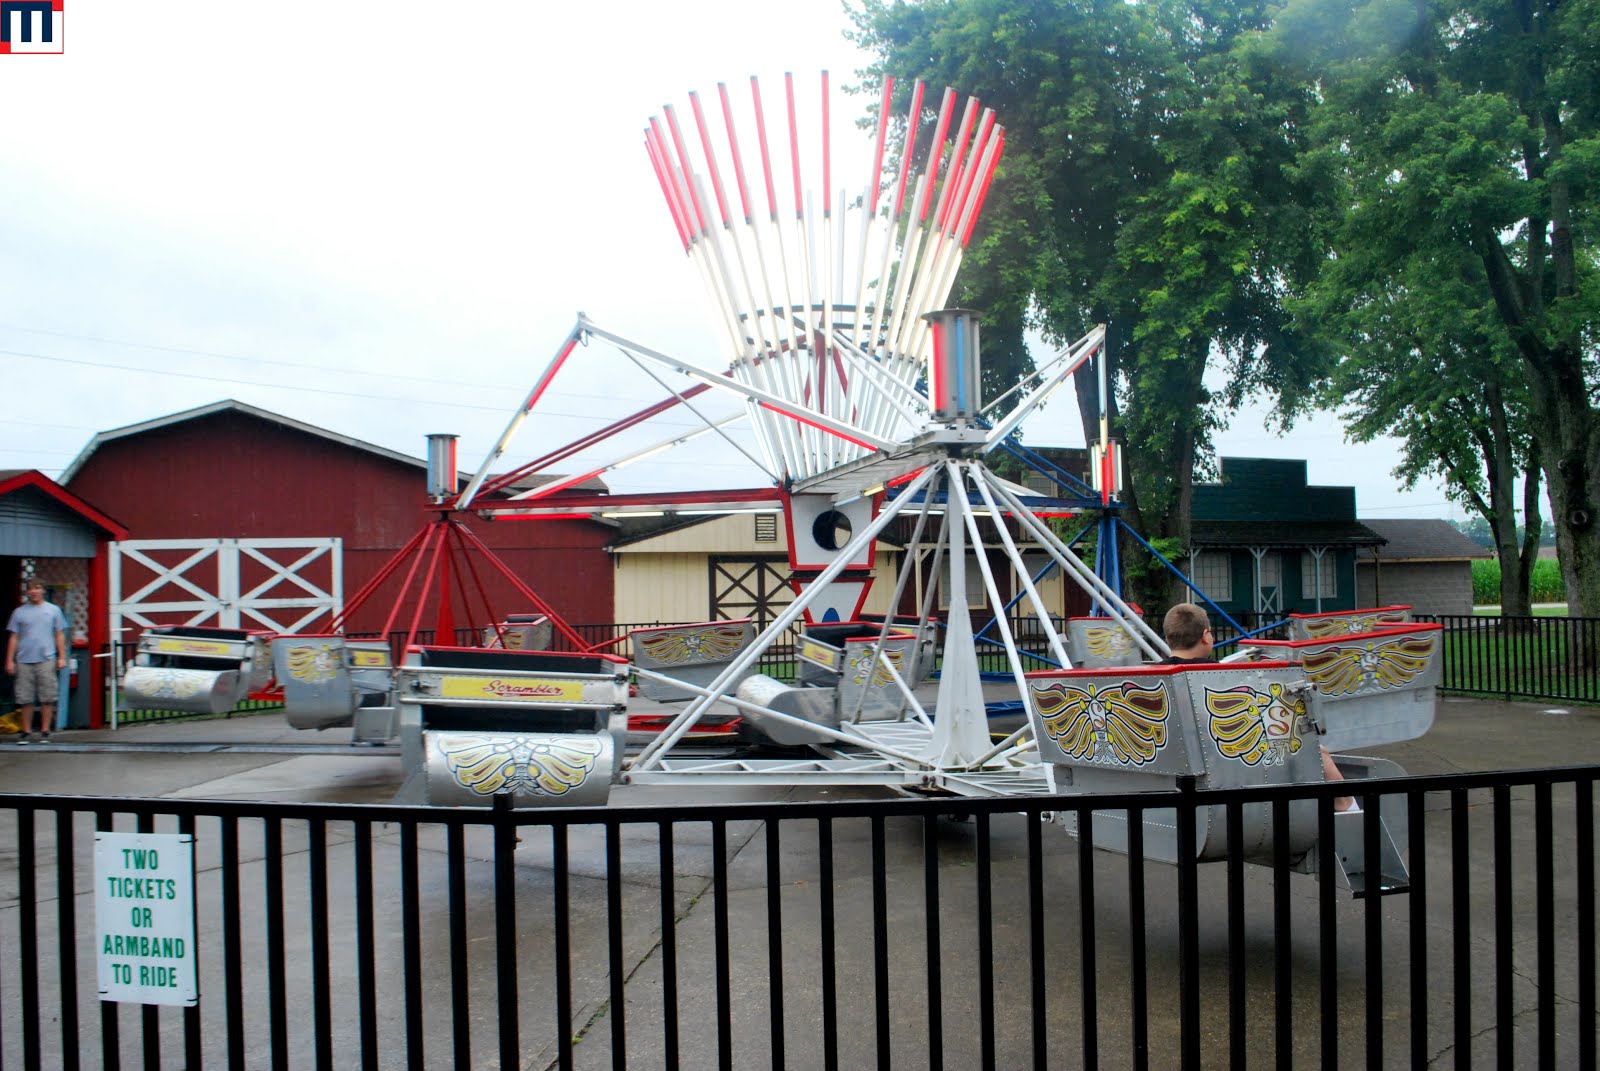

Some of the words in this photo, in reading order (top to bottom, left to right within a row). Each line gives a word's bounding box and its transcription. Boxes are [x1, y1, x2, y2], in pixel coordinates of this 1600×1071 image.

[482, 679, 564, 696] Scrambler
[1267, 705, 1290, 737] S
[121, 848, 158, 870] TWO
[107, 876, 176, 900] TICKETS
[131, 906, 153, 928] OR
[103, 934, 185, 959] ARMBAND
[112, 963, 132, 985] TO
[140, 965, 178, 988] RIDE
